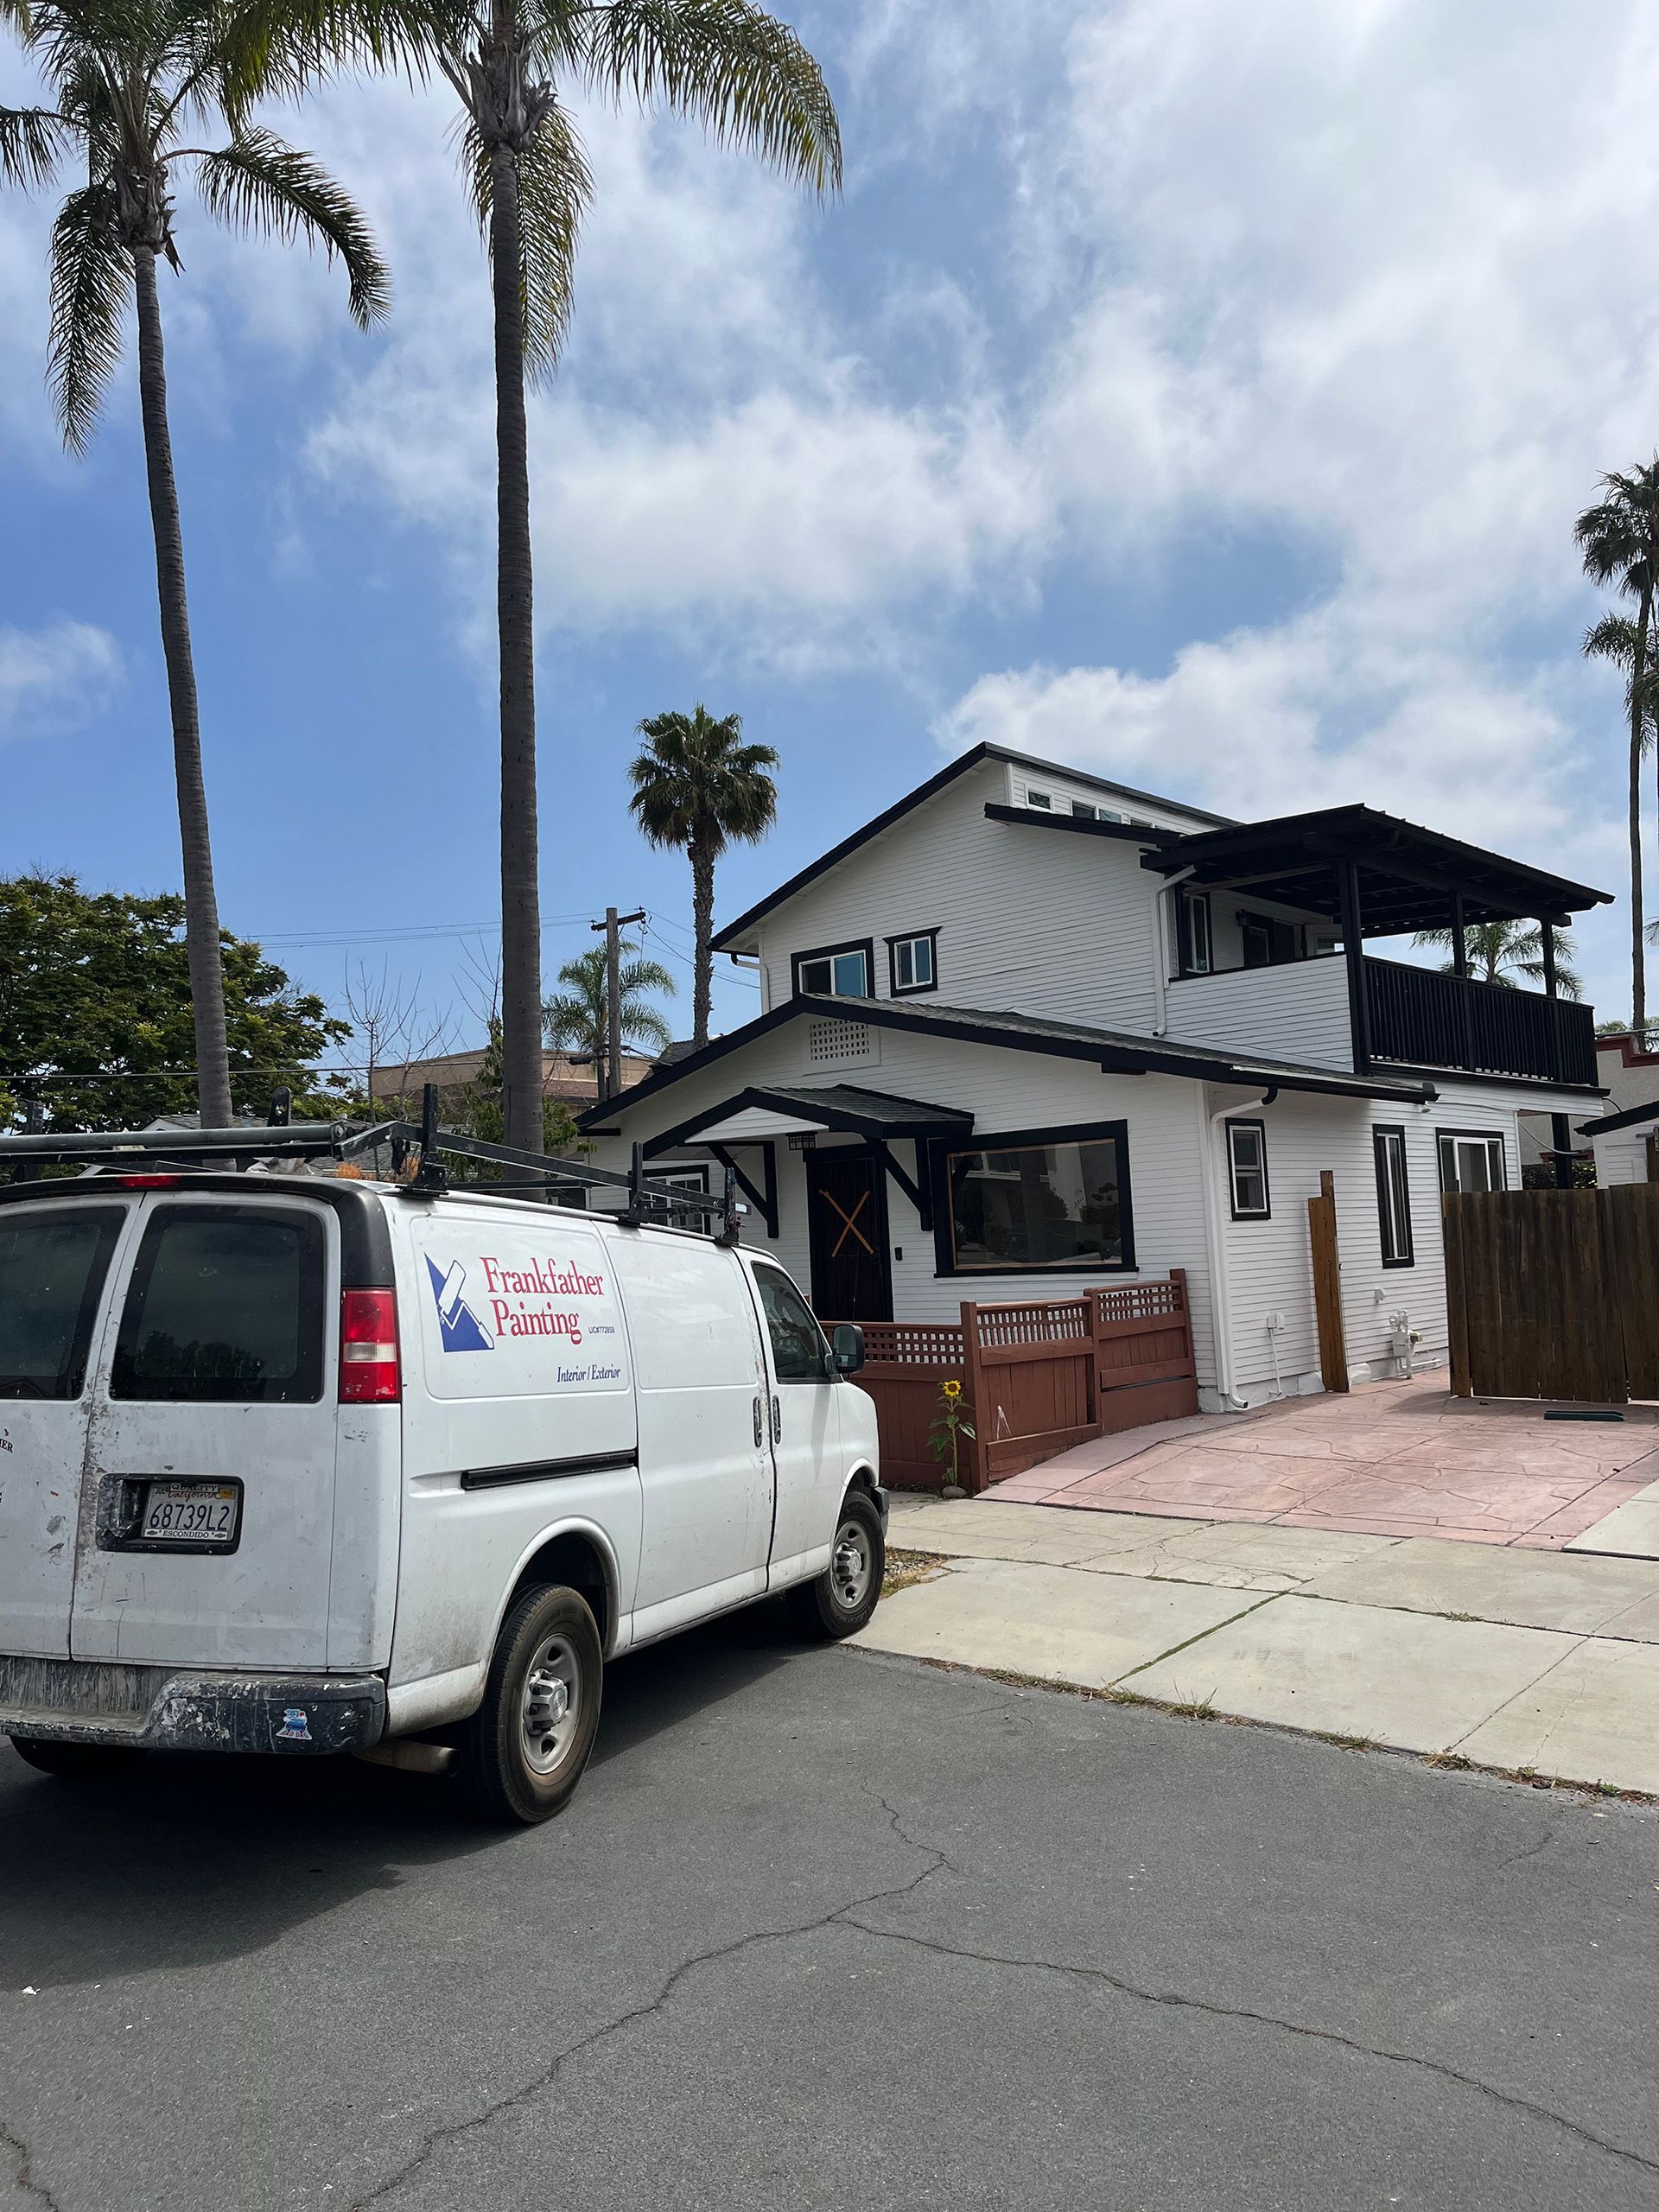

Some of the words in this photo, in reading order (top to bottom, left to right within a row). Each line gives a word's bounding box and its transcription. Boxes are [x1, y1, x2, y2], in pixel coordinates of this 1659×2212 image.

[479, 1256, 605, 1295] Frankfather
[490, 1299, 582, 1345] Painting
[556, 1365, 587, 1382] Interior
[591, 1363, 621, 1380] Exterior
[149, 1503, 230, 1531] 68739L2
[162, 1530, 210, 1539] ESCONDIDO
